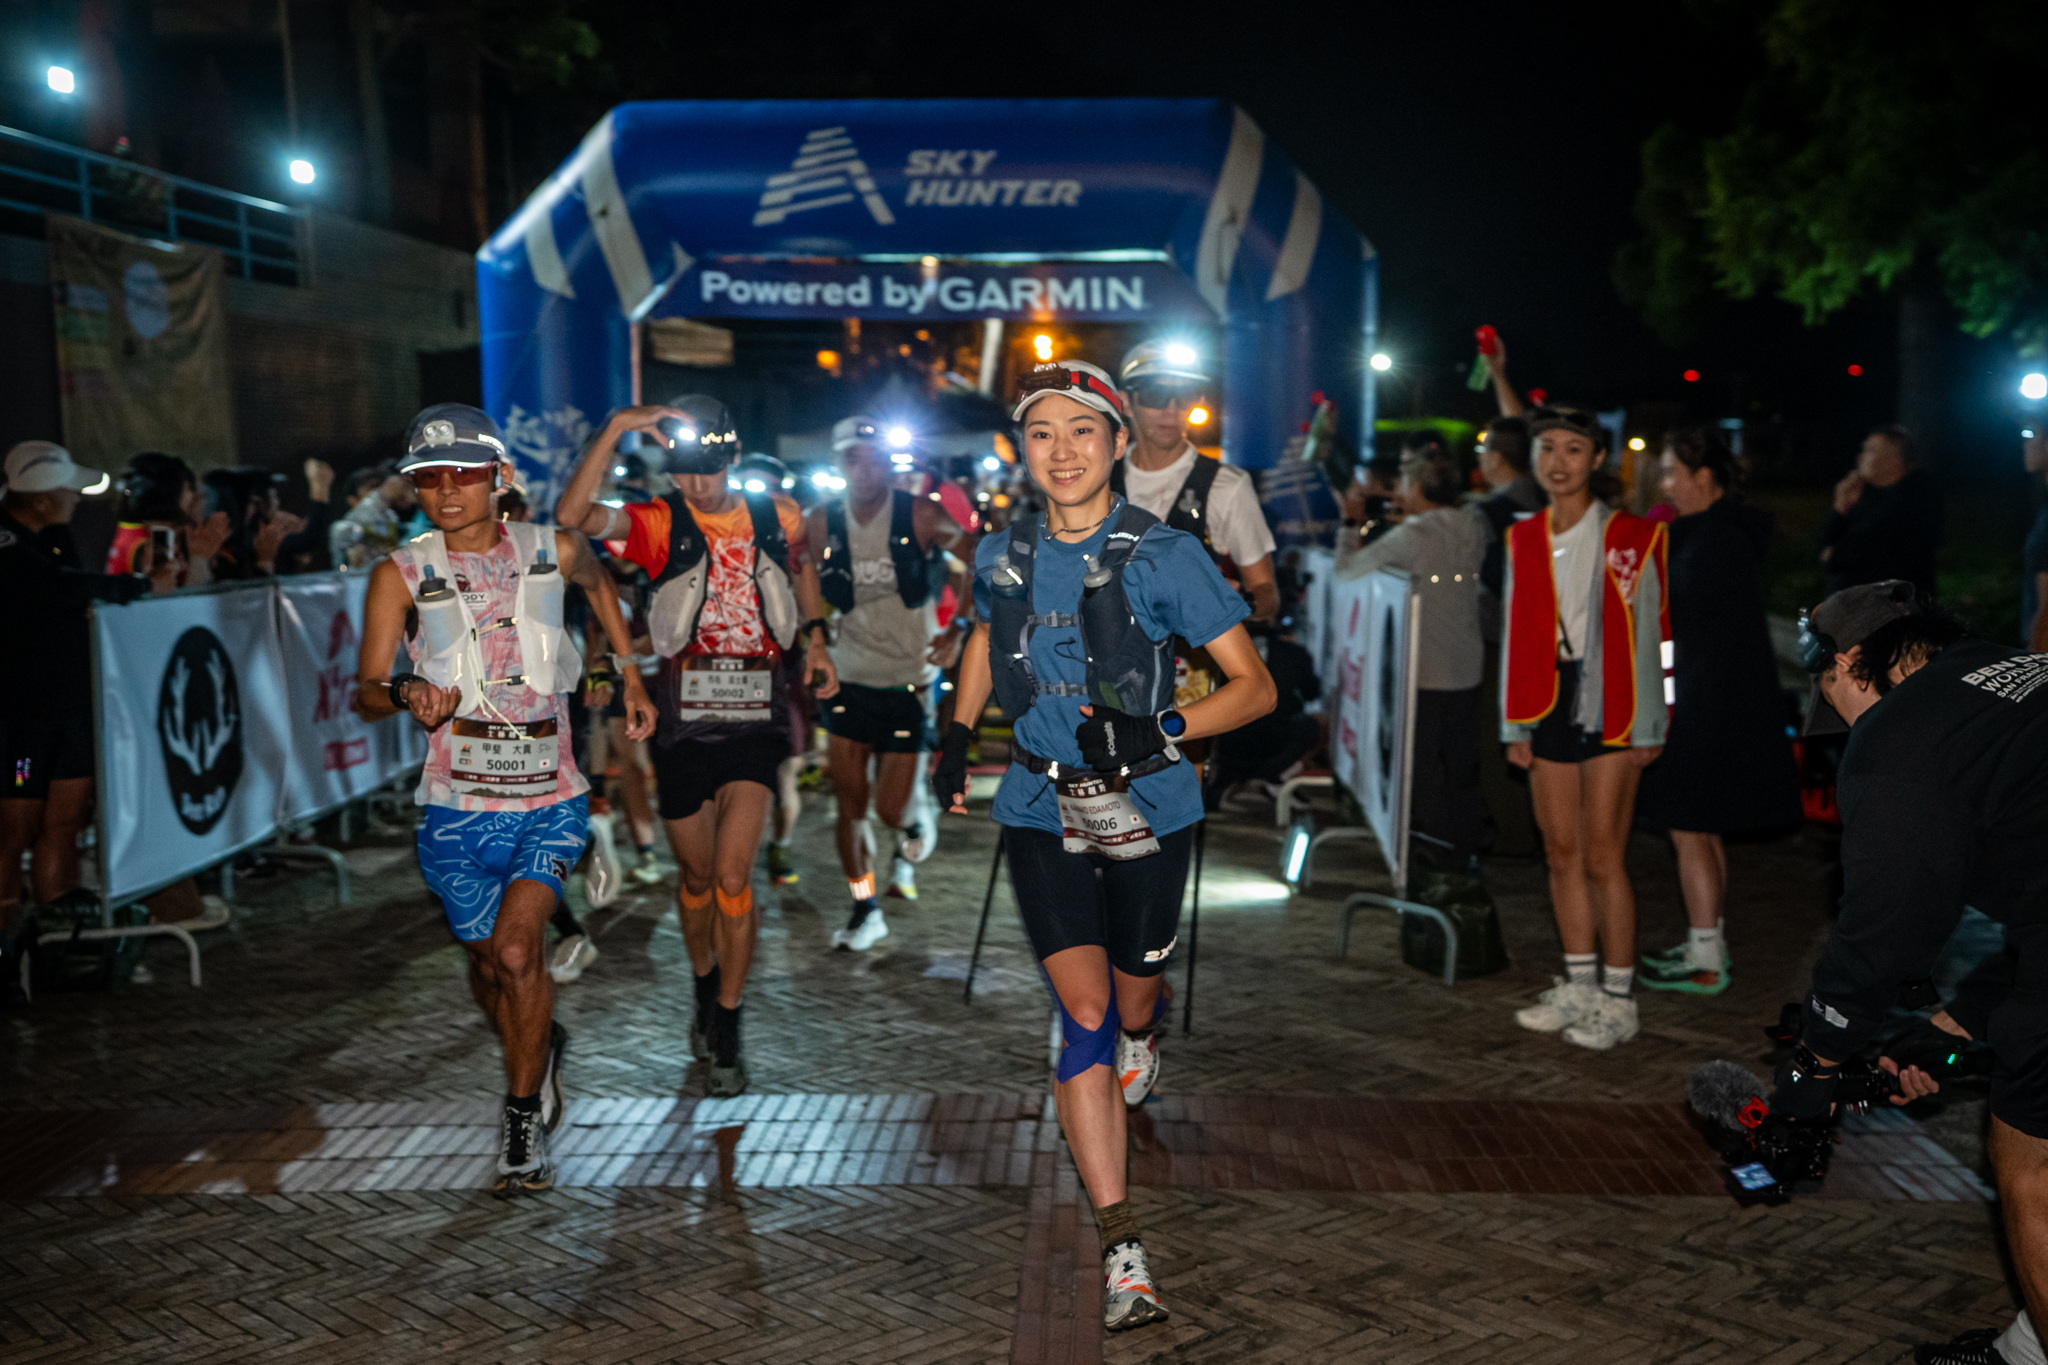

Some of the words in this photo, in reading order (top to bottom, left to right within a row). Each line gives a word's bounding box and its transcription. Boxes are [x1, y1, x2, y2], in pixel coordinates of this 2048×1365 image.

[903, 148, 997, 177] SKY
[903, 178, 1083, 208] HUNTER
[700, 270, 871, 308] Powered
[883, 276, 927, 314] by
[938, 275, 1146, 312] GARMIN
[1961, 660, 2016, 686] BEN
[1980, 662, 2040, 692] WORLD
[1997, 682, 2017, 698] SAN
[486, 759, 526, 771] 50001
